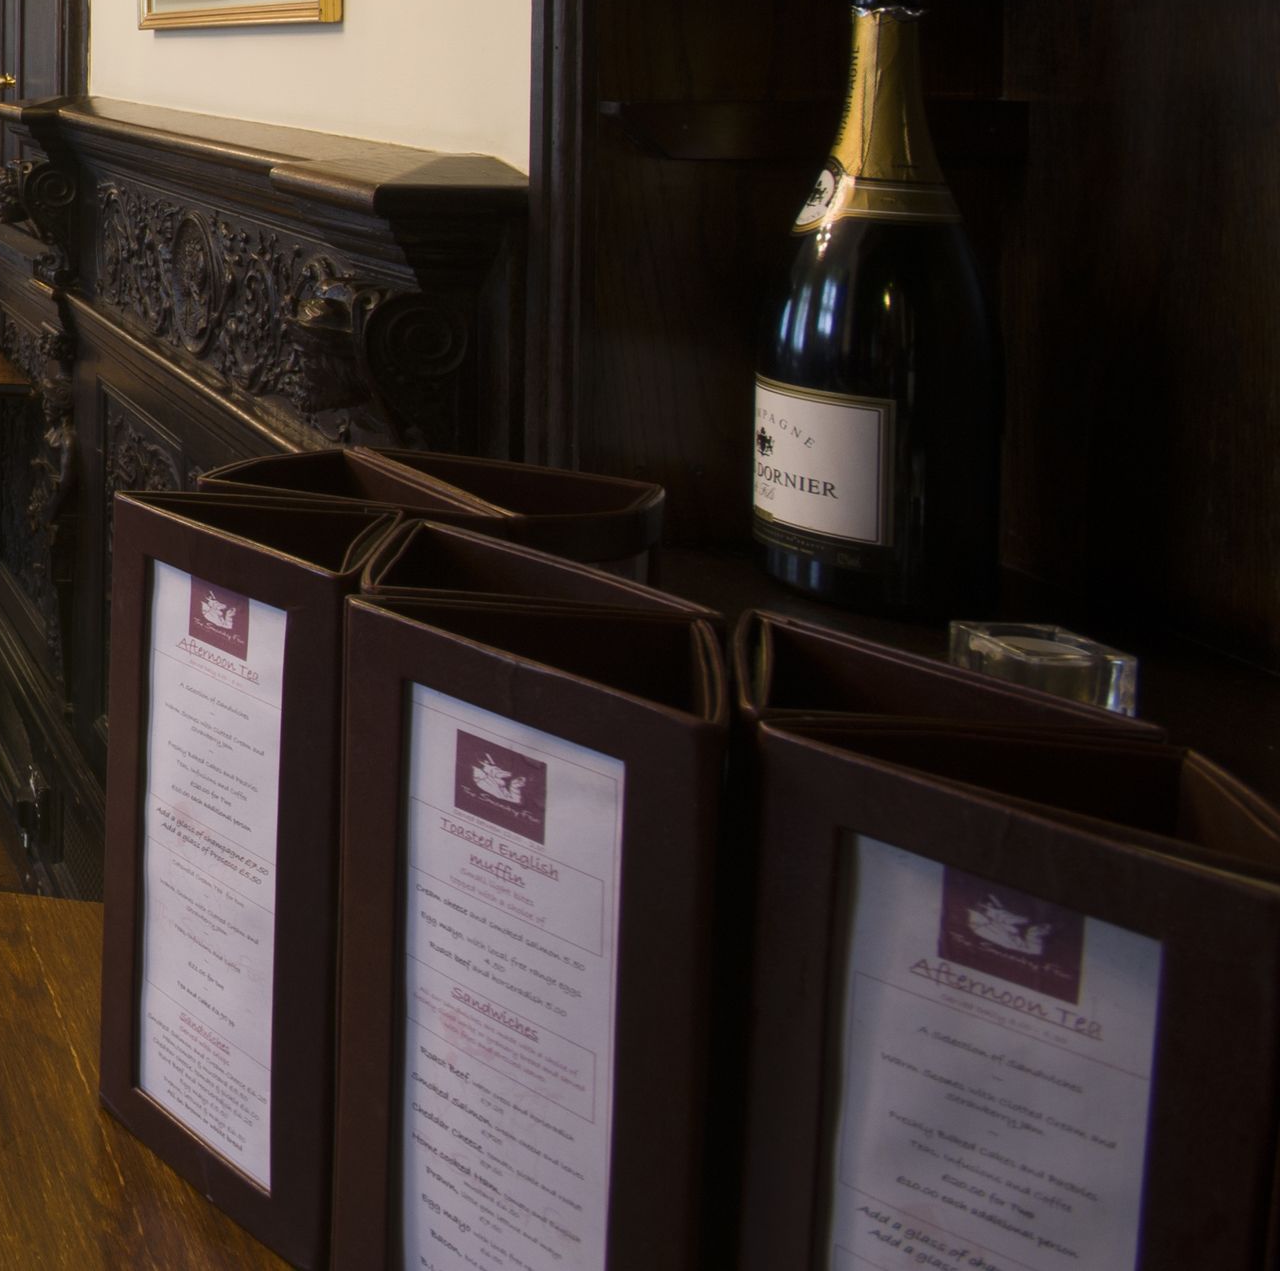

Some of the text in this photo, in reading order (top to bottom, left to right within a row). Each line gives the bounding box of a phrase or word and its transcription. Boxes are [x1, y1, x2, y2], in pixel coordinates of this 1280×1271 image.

[757, 462, 840, 500] DORNIER
[176, 638, 235, 673] Afternoon
[238, 665, 259, 685] Tea
[440, 817, 493, 851] Toasted
[498, 844, 558, 880] English
[469, 855, 524, 887] muffin
[469, 911, 486, 923] and
[451, 987, 537, 1041] Sandwiches
[909, 960, 1046, 1020] Afternoon
[1054, 1009, 1101, 1040] Tea
[857, 1206, 889, 1223] Add
[868, 1230, 901, 1247] Add
